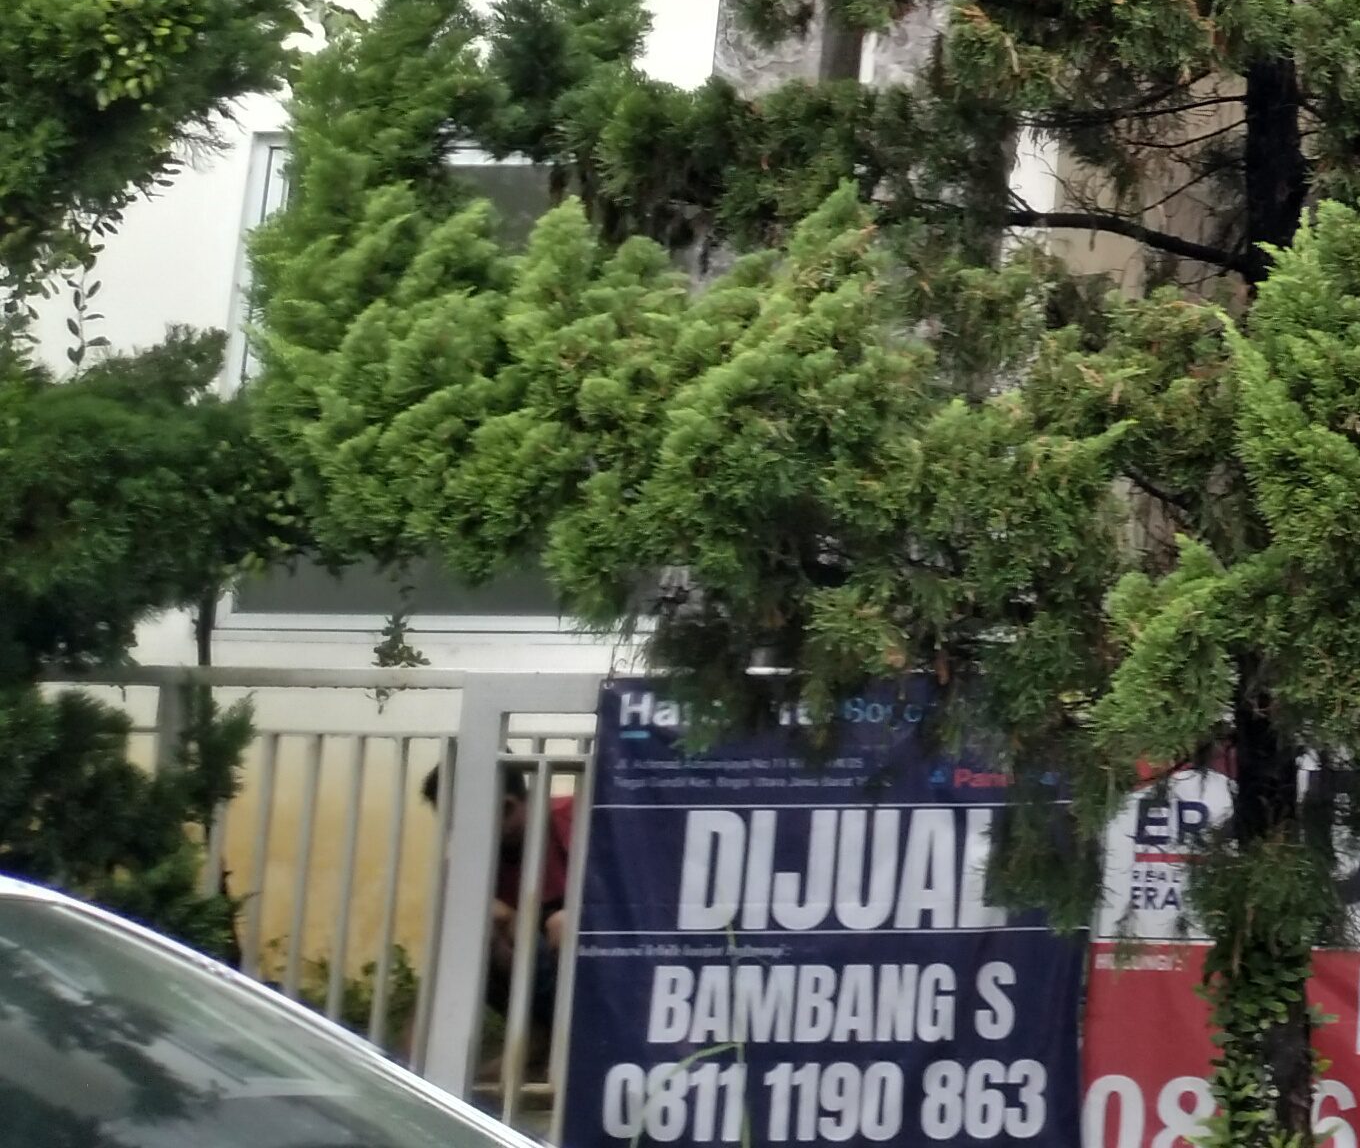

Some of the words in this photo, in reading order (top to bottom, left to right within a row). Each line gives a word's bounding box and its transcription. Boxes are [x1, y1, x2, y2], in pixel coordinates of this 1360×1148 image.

[677, 809, 1008, 930] DIJUAL
[647, 964, 956, 1043] BAMBANG
[973, 962, 1016, 1040] S
[602, 1062, 746, 1140] 0811
[763, 1061, 904, 1140] 1190
[920, 1059, 1047, 1139] 863
[1080, 1074, 1357, 1148] 086
